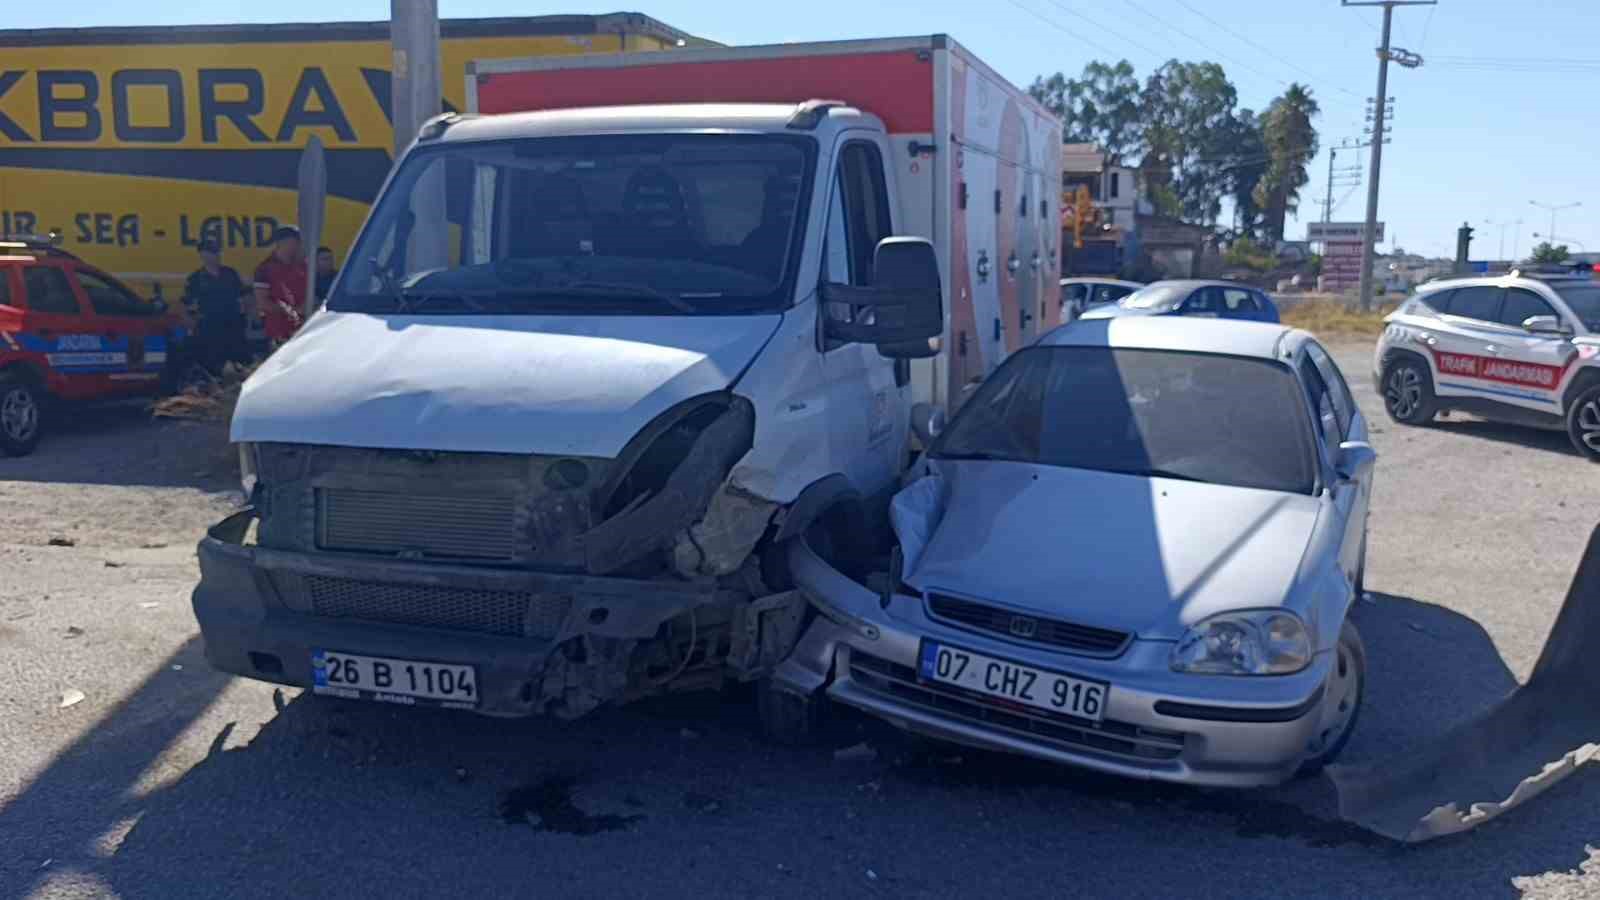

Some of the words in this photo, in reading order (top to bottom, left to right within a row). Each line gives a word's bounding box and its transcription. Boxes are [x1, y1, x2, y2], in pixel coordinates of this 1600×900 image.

[75, 212, 140, 247] SEA
[180, 214, 279, 249] LAND
[326, 656, 360, 685] 26
[373, 661, 393, 688] B
[406, 664, 474, 697] 1104
[936, 649, 970, 681] 07
[984, 663, 1037, 701] CHZ
[1050, 680, 1102, 715] 916
